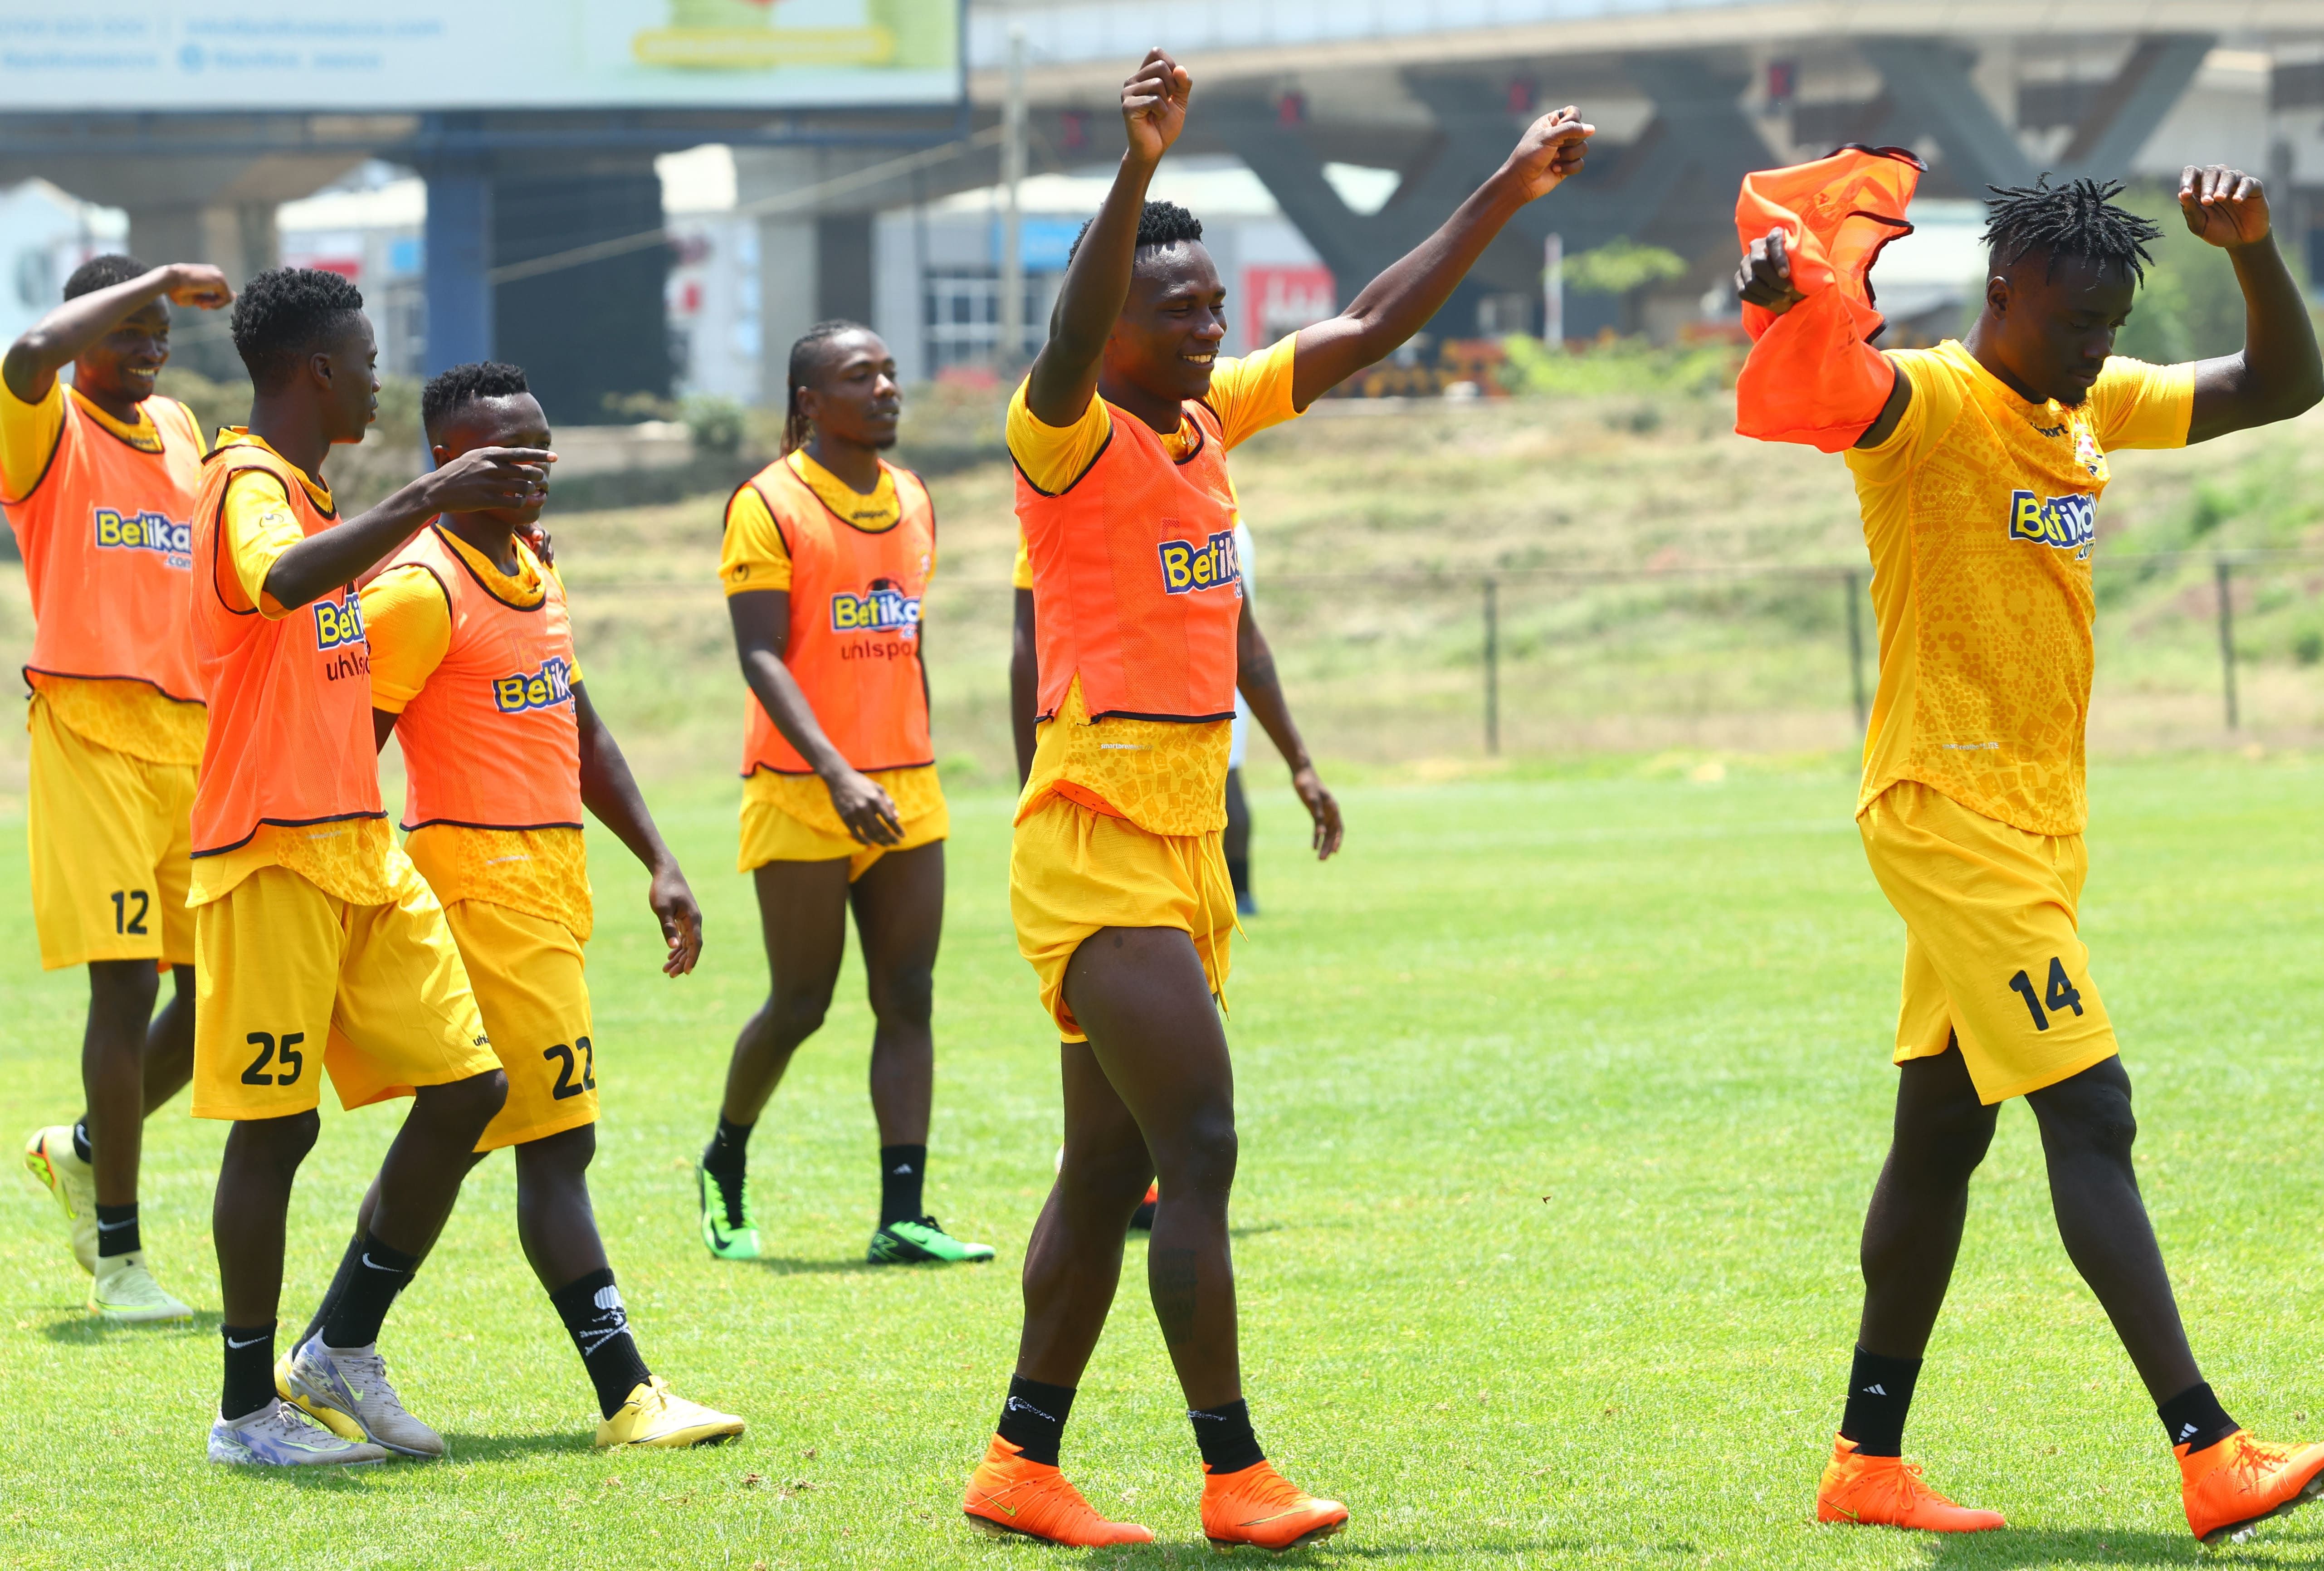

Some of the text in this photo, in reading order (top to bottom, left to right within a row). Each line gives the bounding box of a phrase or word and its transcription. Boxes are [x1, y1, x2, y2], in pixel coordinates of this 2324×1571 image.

[1164, 537, 1240, 587] Betik
[318, 599, 364, 644] Beti
[111, 889, 149, 935] 12
[2009, 956, 2084, 1031] 14
[241, 1031, 304, 1086] 25
[543, 1036, 596, 1100] 22
